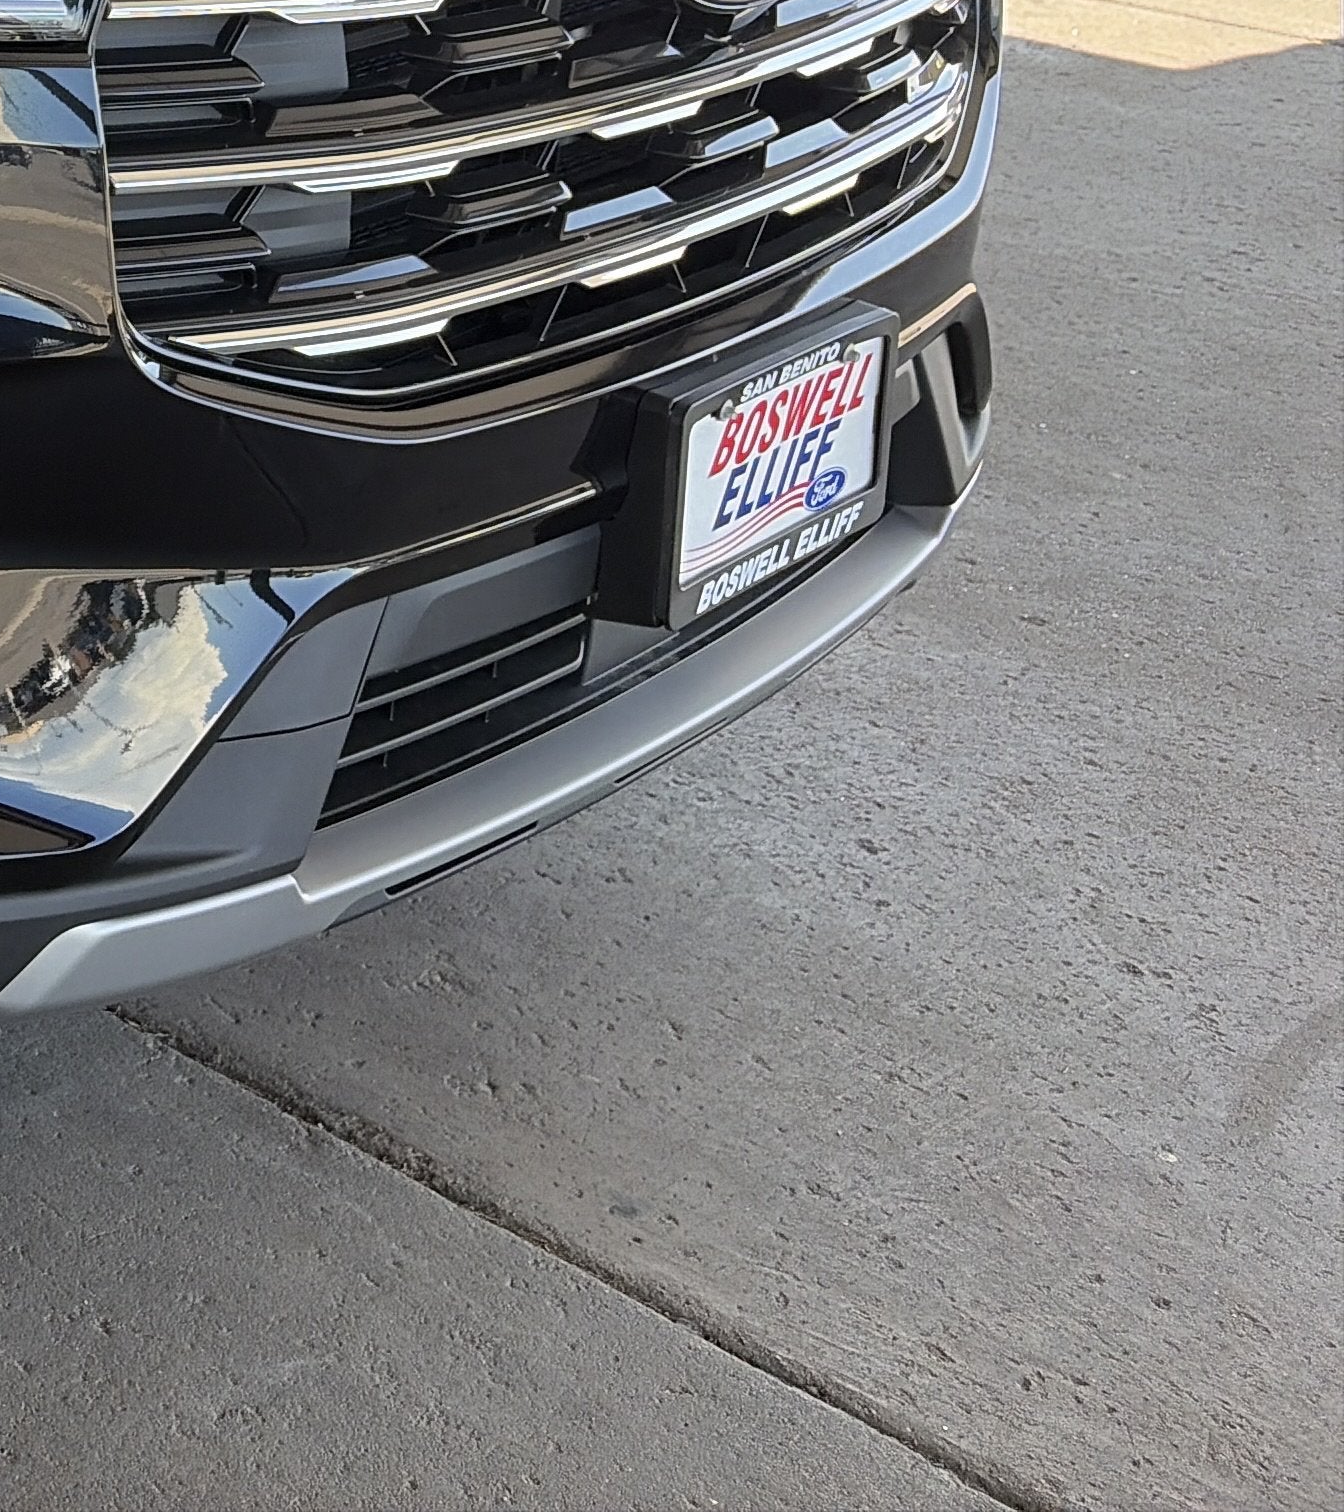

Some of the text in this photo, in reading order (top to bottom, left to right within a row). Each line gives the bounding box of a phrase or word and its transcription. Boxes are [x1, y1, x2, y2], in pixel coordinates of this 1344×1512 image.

[707, 352, 874, 478] BOSWELL
[740, 341, 841, 402] SAN BENITO
[712, 419, 843, 530] ELLIFF
[812, 472, 842, 504] Ford
[696, 499, 864, 615] BOSWELL ELLIFF
